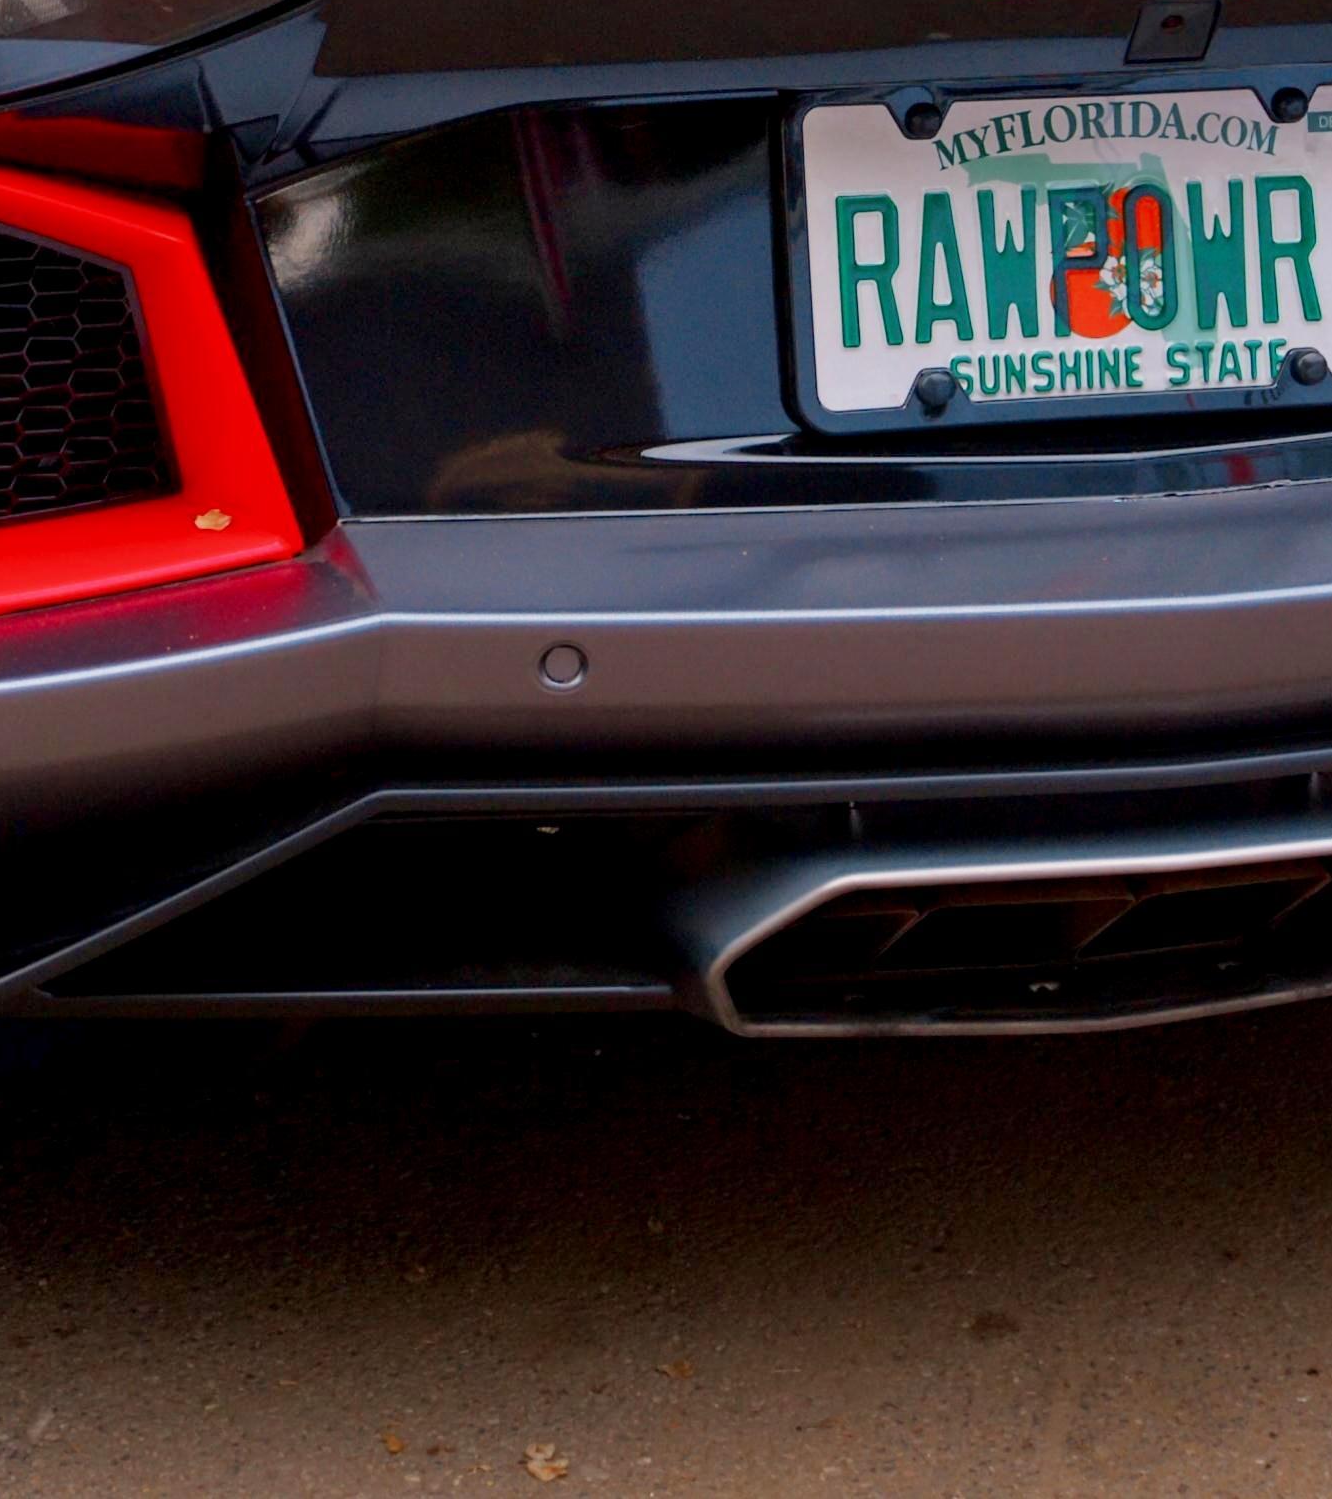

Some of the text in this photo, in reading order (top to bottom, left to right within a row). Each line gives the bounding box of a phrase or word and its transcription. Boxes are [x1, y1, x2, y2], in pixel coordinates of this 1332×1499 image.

[932, 102, 1280, 171] MYFLORIDA.COM
[835, 174, 1323, 349] RAWPOWR
[951, 337, 1288, 397] SUNSHINE STATE
